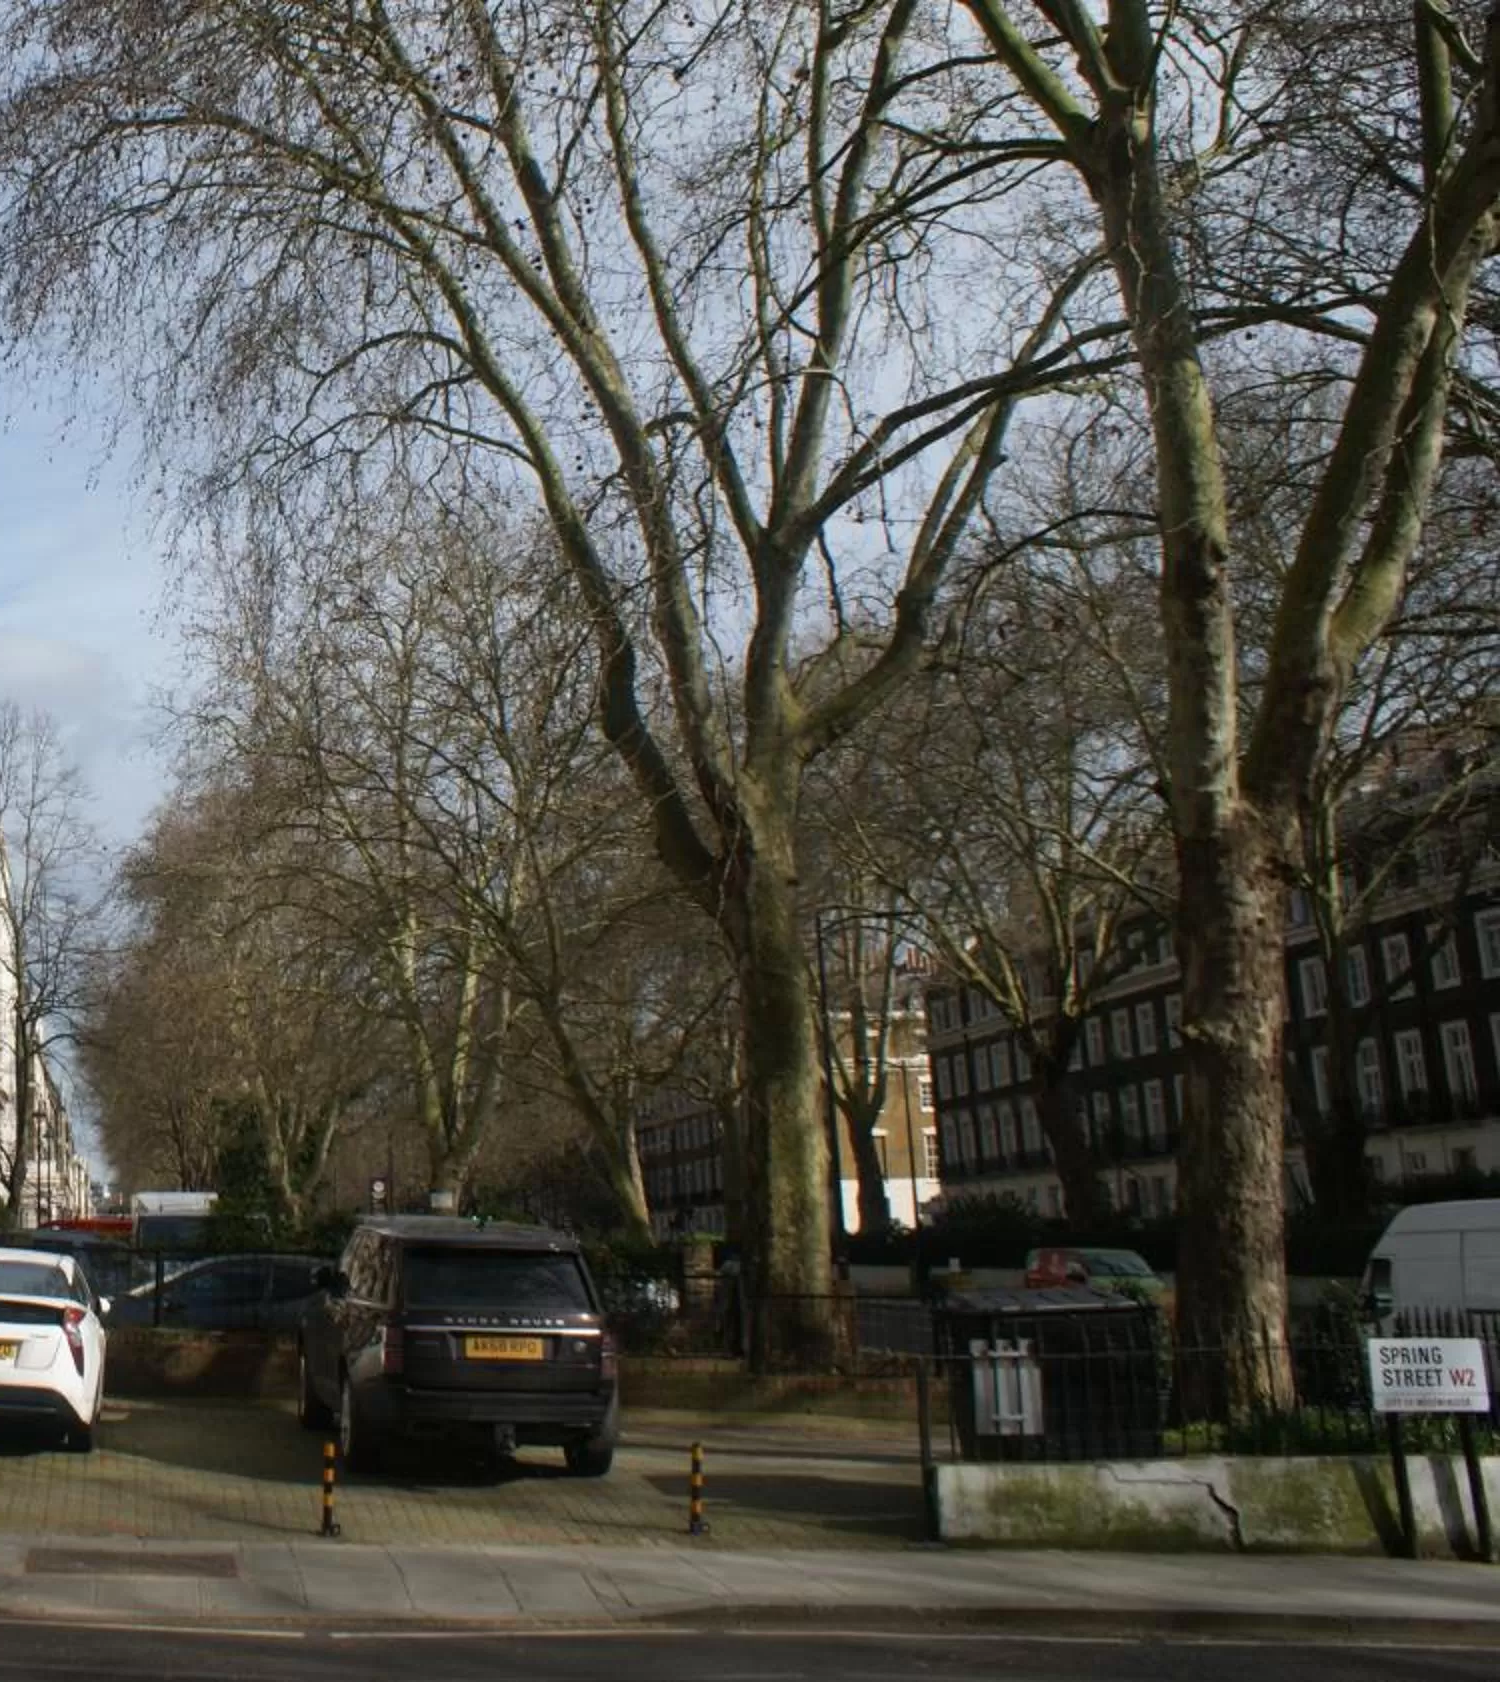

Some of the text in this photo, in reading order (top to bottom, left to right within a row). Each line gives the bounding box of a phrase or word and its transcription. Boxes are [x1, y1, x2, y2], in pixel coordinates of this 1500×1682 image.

[1379, 1346, 1443, 1365] SPRING
[1382, 1368, 1476, 1387] STREET W2
